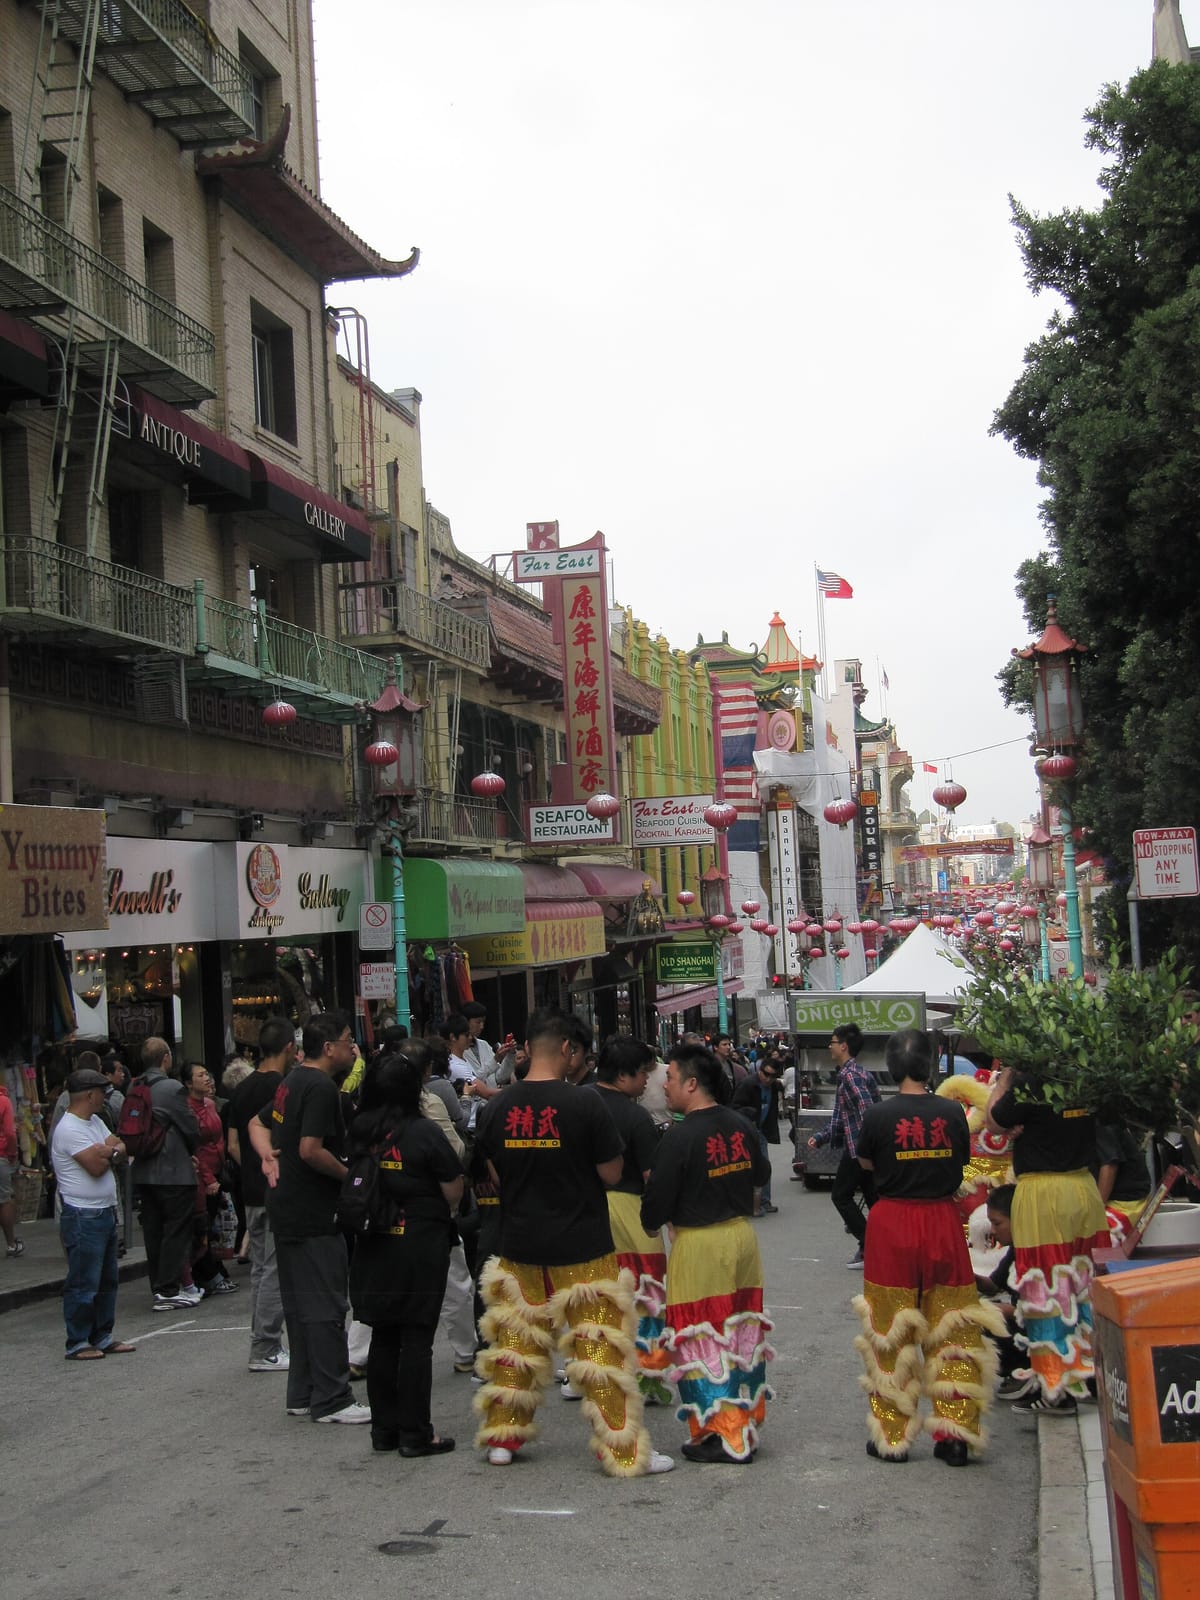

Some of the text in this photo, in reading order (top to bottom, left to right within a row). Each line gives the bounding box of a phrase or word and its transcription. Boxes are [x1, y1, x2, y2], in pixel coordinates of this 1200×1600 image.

[140, 412, 201, 468] ANTIQUE
[303, 502, 346, 541] GALLERY
[522, 553, 593, 573] Far East
[568, 584, 605, 793] 康年海鮮酒家
[535, 808, 598, 824] SEAFOO
[634, 800, 709, 818] Far East CAF
[534, 823, 610, 837] RESTAURANT
[635, 815, 705, 828] SEAFOOD CUISIN
[865, 807, 877, 845] FOUR
[634, 827, 713, 839] COCKTAIL KARAOKE
[782, 816, 791, 856] Bank
[1137, 830, 1190, 840] TOW-AWAY
[1, 830, 100, 883] Yummy
[1137, 843, 1193, 858] NO STOPPING
[867, 852, 879, 882] SEA
[1156, 859, 1178, 871] ANY
[785, 867, 792, 885] of
[1155, 872, 1181, 884] TIME
[21, 877, 86, 918] Bites
[298, 871, 351, 922] Gallery
[491, 936, 523, 948] Cuisine
[486, 950, 508, 962] Dim
[661, 956, 713, 967] OLD SHANGHAI
[796, 999, 882, 1024] ONIGILLY
[504, 1105, 560, 1138] 精武
[894, 1116, 953, 1150] 精武
[706, 1131, 751, 1167] 精武
